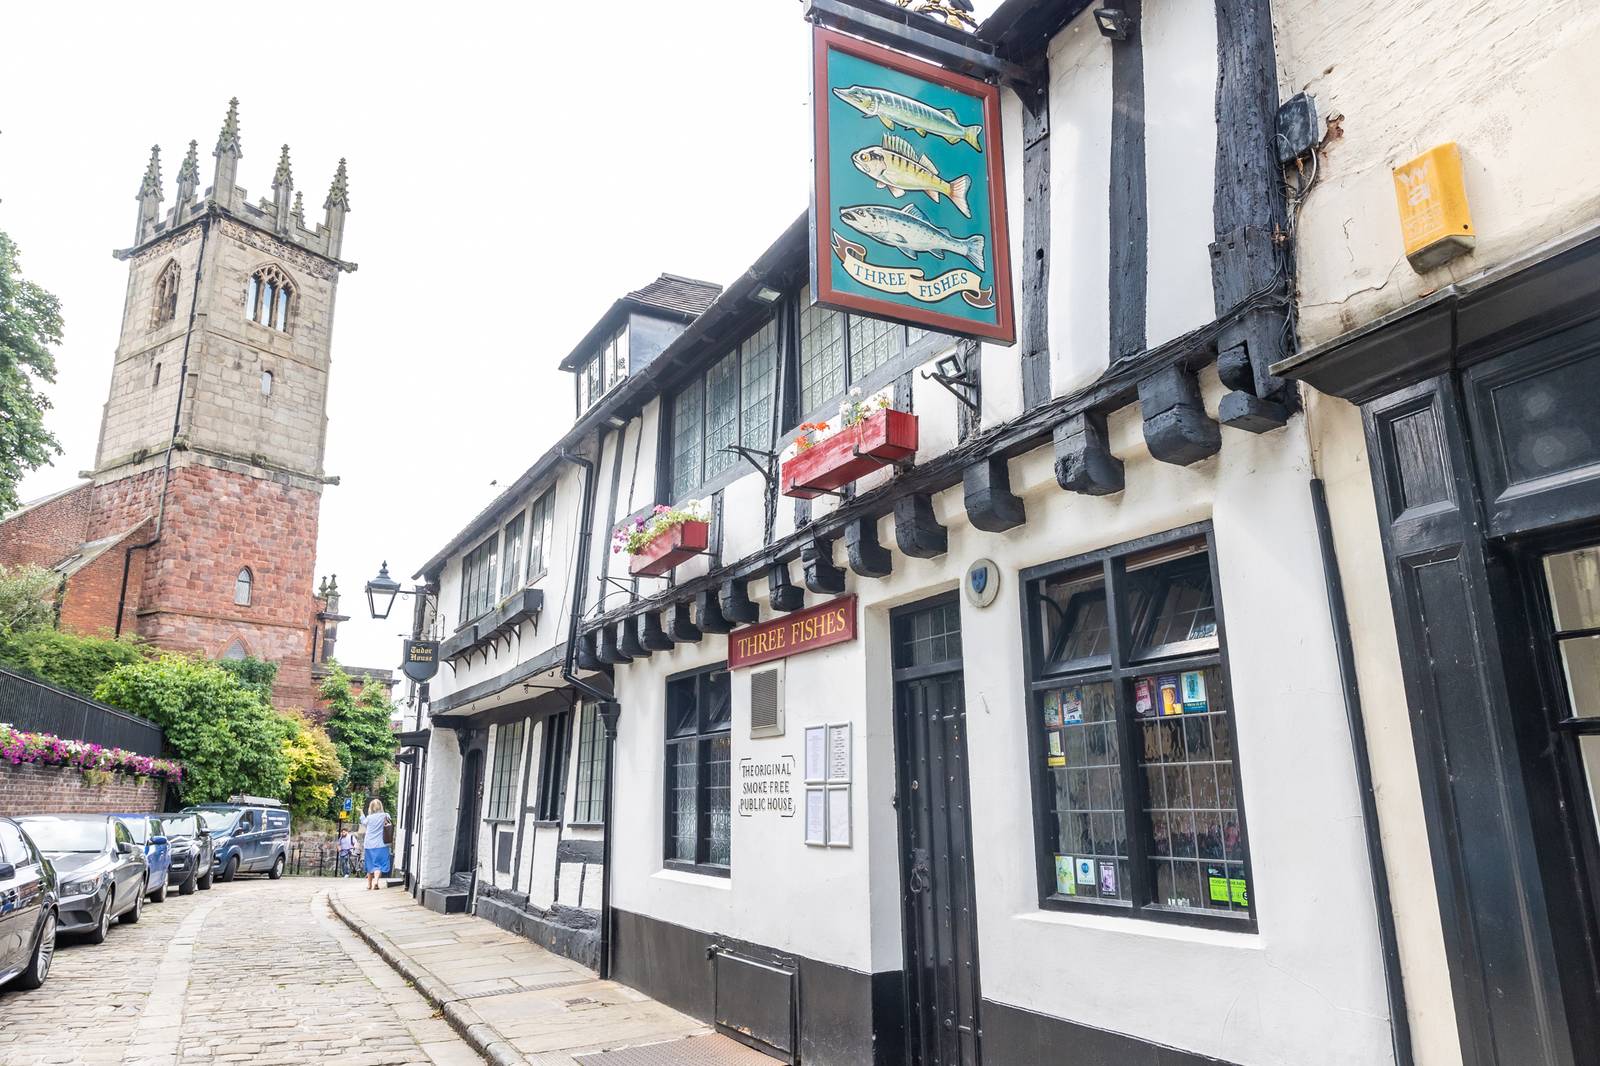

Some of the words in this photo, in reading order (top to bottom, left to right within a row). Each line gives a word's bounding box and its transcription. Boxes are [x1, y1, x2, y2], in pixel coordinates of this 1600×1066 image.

[854, 264, 906, 285] THREE
[920, 273, 967, 297] FISHES
[737, 627, 786, 658] THREE
[791, 607, 846, 645] FISHES
[410, 646, 432, 654] Tudor
[410, 653, 432, 661] House
[741, 764, 754, 778] THE
[754, 763, 791, 777] ORIGINAL
[740, 797, 766, 811] PUBLIC
[767, 797, 793, 811] HOUSE
